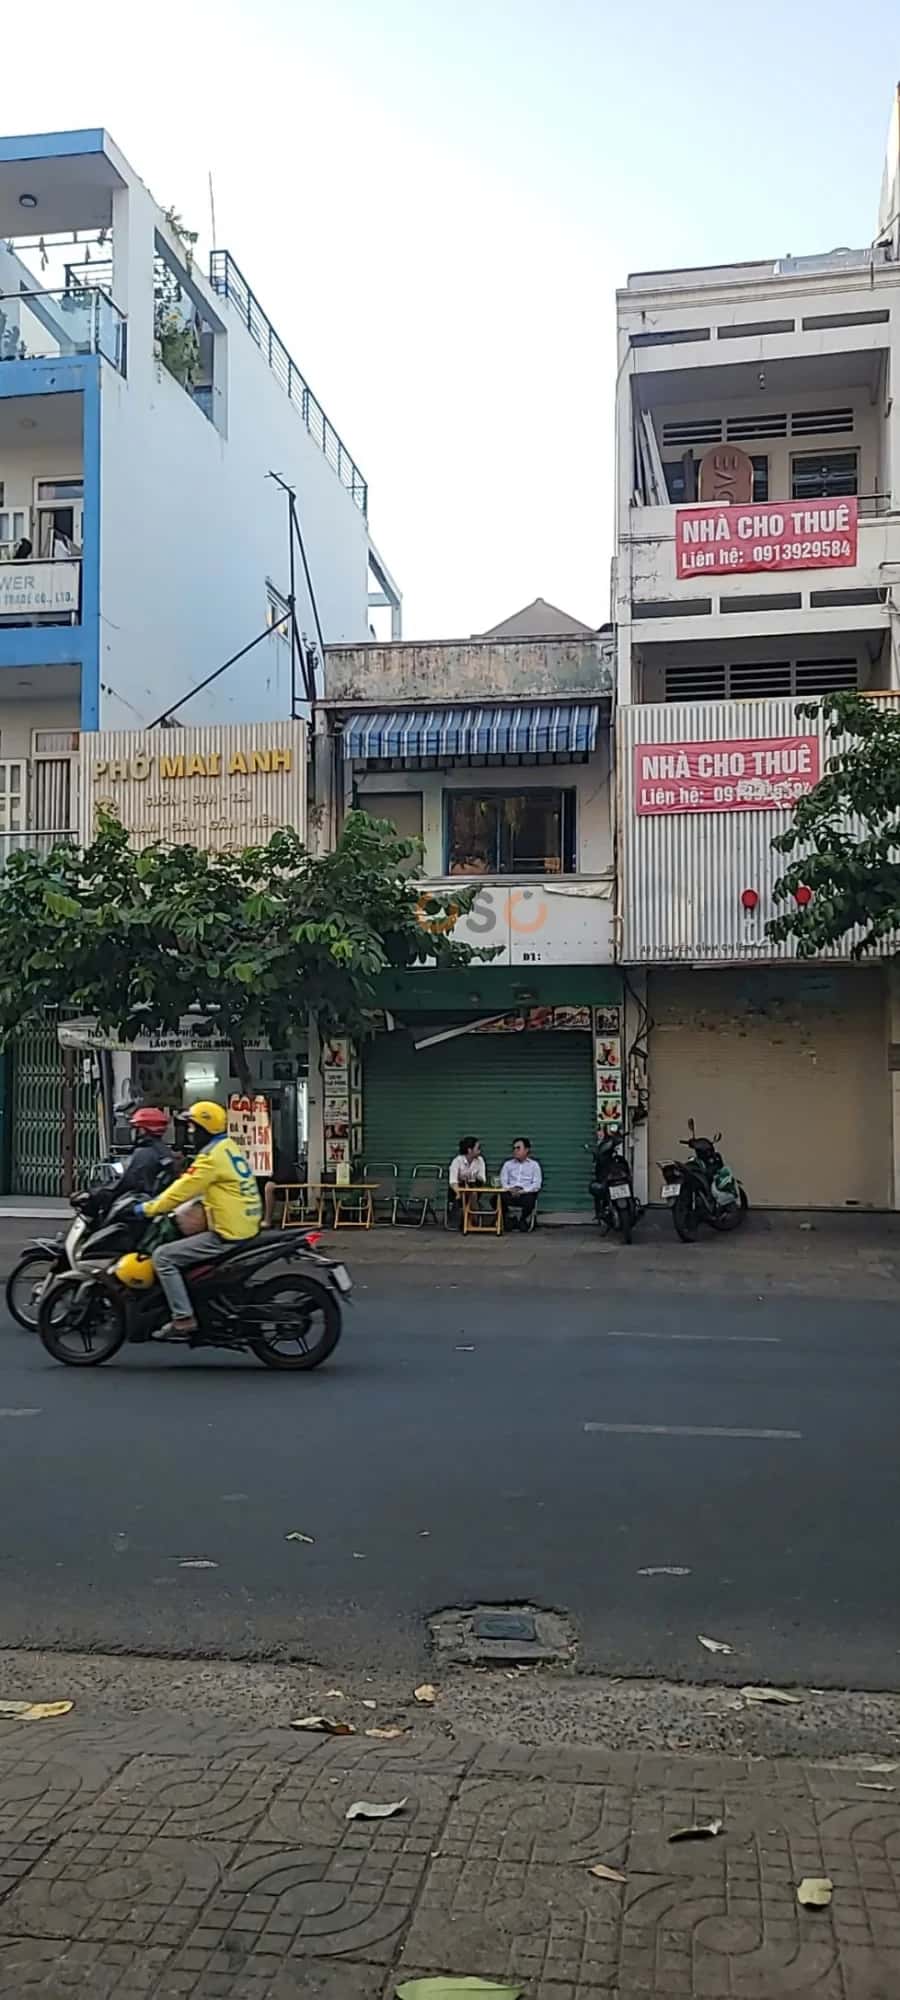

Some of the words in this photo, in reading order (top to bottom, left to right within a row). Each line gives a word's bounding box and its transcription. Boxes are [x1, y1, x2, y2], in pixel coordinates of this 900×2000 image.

[682, 514, 731, 544] NHÀ
[737, 514, 784, 540] CHO
[791, 504, 850, 534] THUÊ
[682, 550, 715, 569] Liên
[719, 548, 744, 568] hệ:
[752, 540, 850, 562] 0913929584
[160, 752, 221, 779] MAI
[228, 748, 292, 775] ANH
[642, 750, 690, 780] NHÀ
[698, 752, 745, 778] CHO
[752, 744, 812, 775] THUÊ
[641, 787, 675, 805] Liên
[679, 786, 704, 807] hệ:
